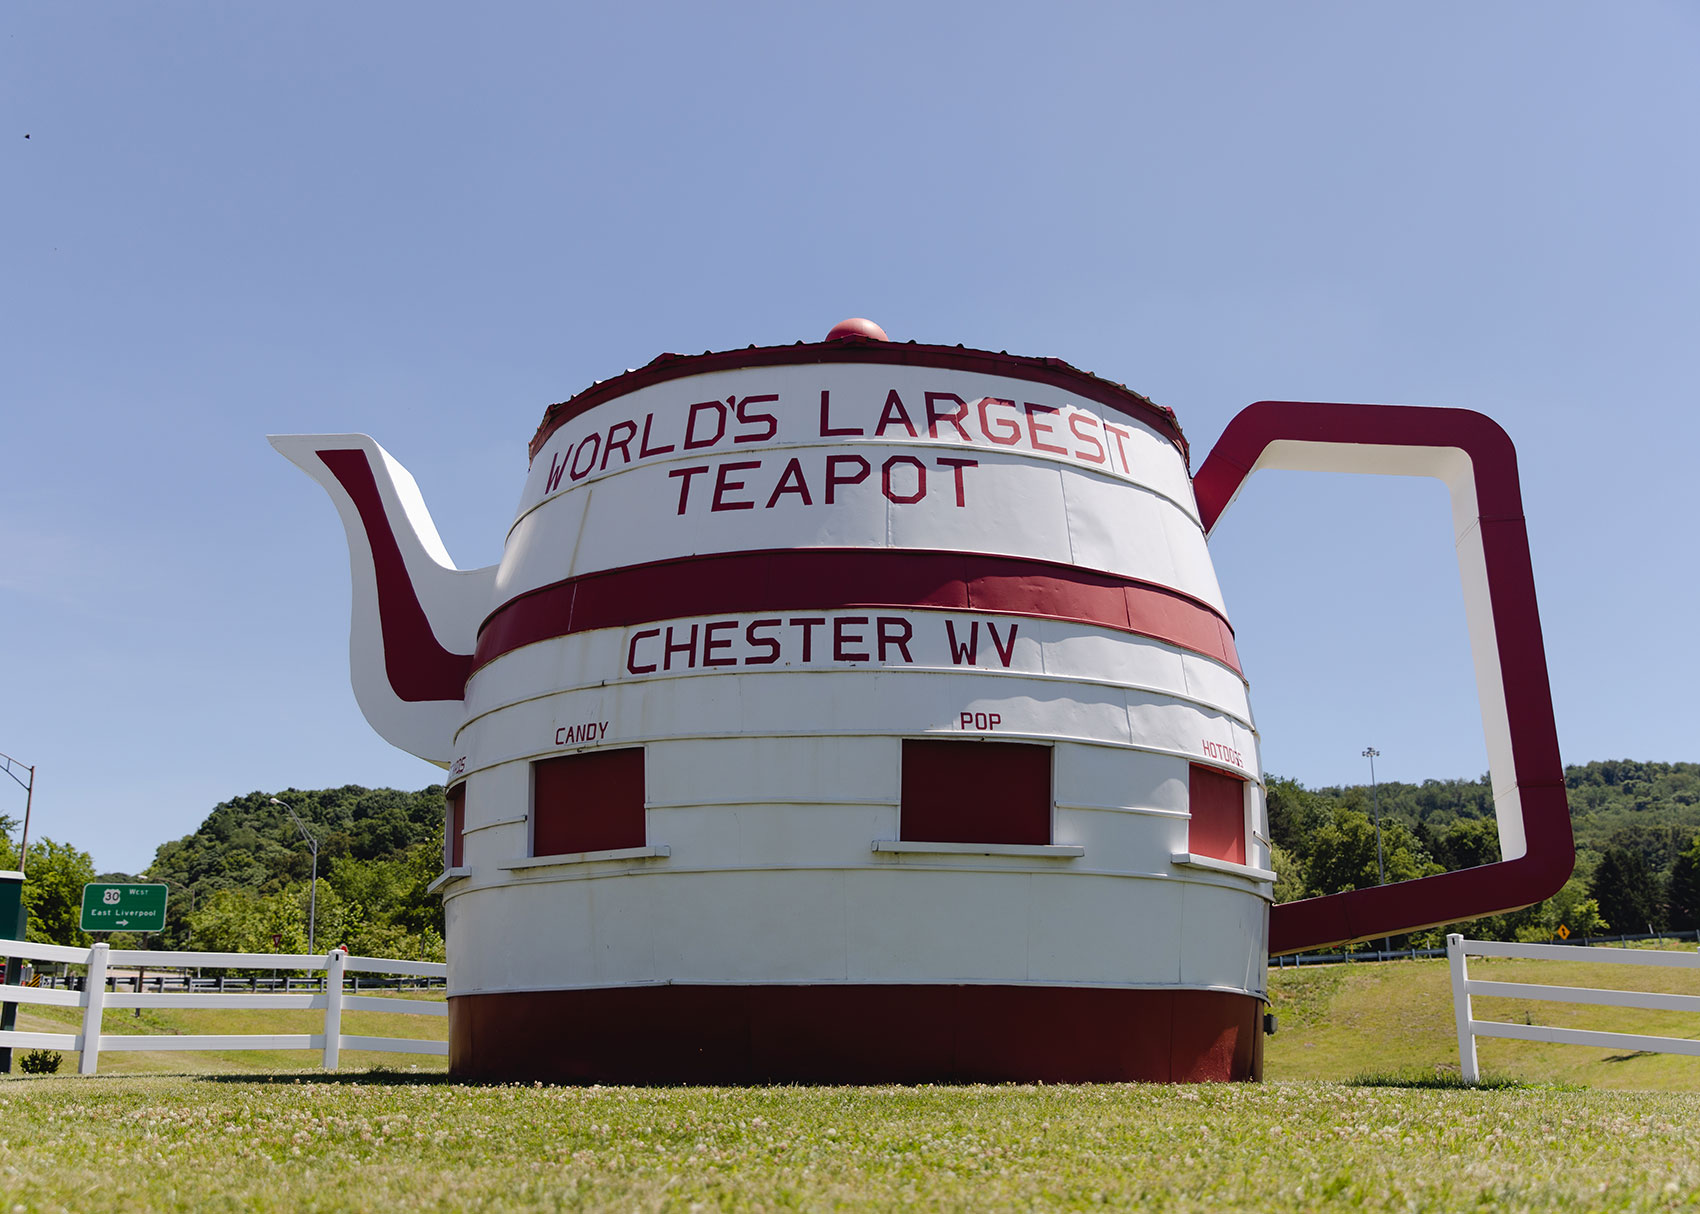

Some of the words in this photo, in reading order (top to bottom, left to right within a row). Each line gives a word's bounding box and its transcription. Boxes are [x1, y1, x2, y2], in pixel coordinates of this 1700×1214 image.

[544, 394, 780, 496] WORLD'S
[819, 388, 1131, 475] LARGEST
[668, 454, 979, 516] TEAPOT
[626, 616, 914, 675] CHESTER
[944, 618, 1019, 668] WV
[555, 721, 609, 745] CANDY
[960, 711, 1002, 731] POP
[105, 892, 120, 901] 30
[115, 909, 156, 917] Liverpool
